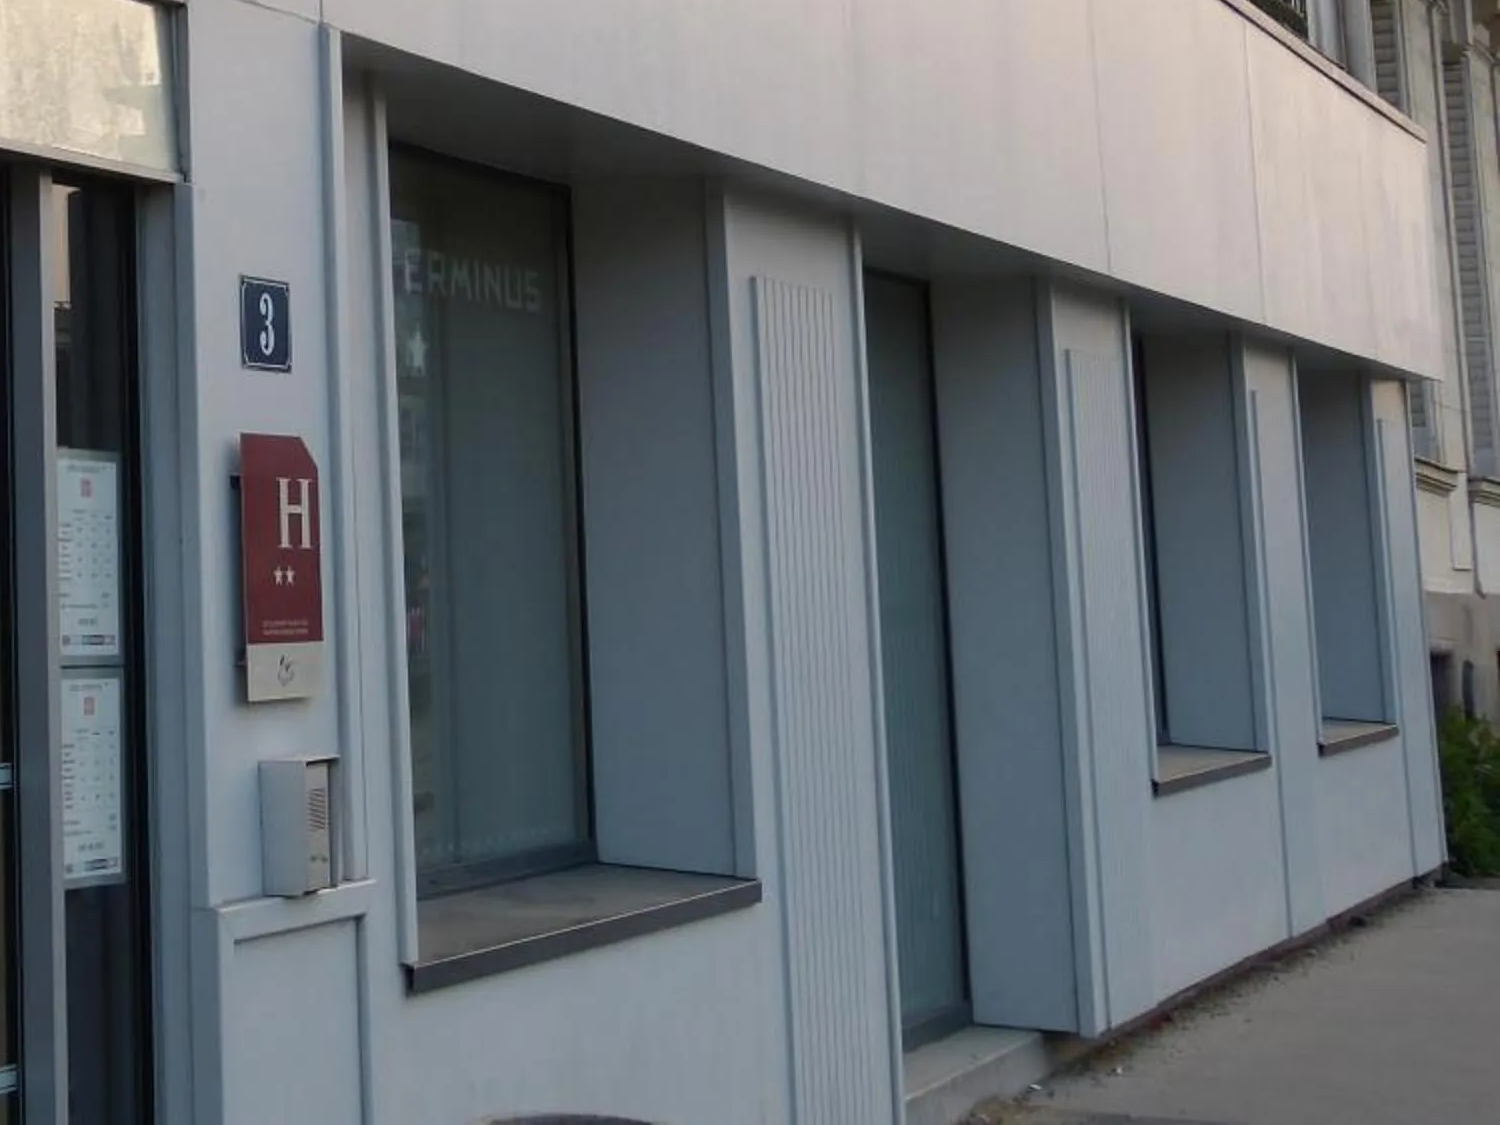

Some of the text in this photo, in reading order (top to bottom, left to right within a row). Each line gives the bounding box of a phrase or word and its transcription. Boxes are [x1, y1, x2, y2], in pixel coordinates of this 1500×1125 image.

[404, 248, 543, 312] ERMINUS
[259, 292, 275, 356] 3
[275, 476, 314, 549] H
